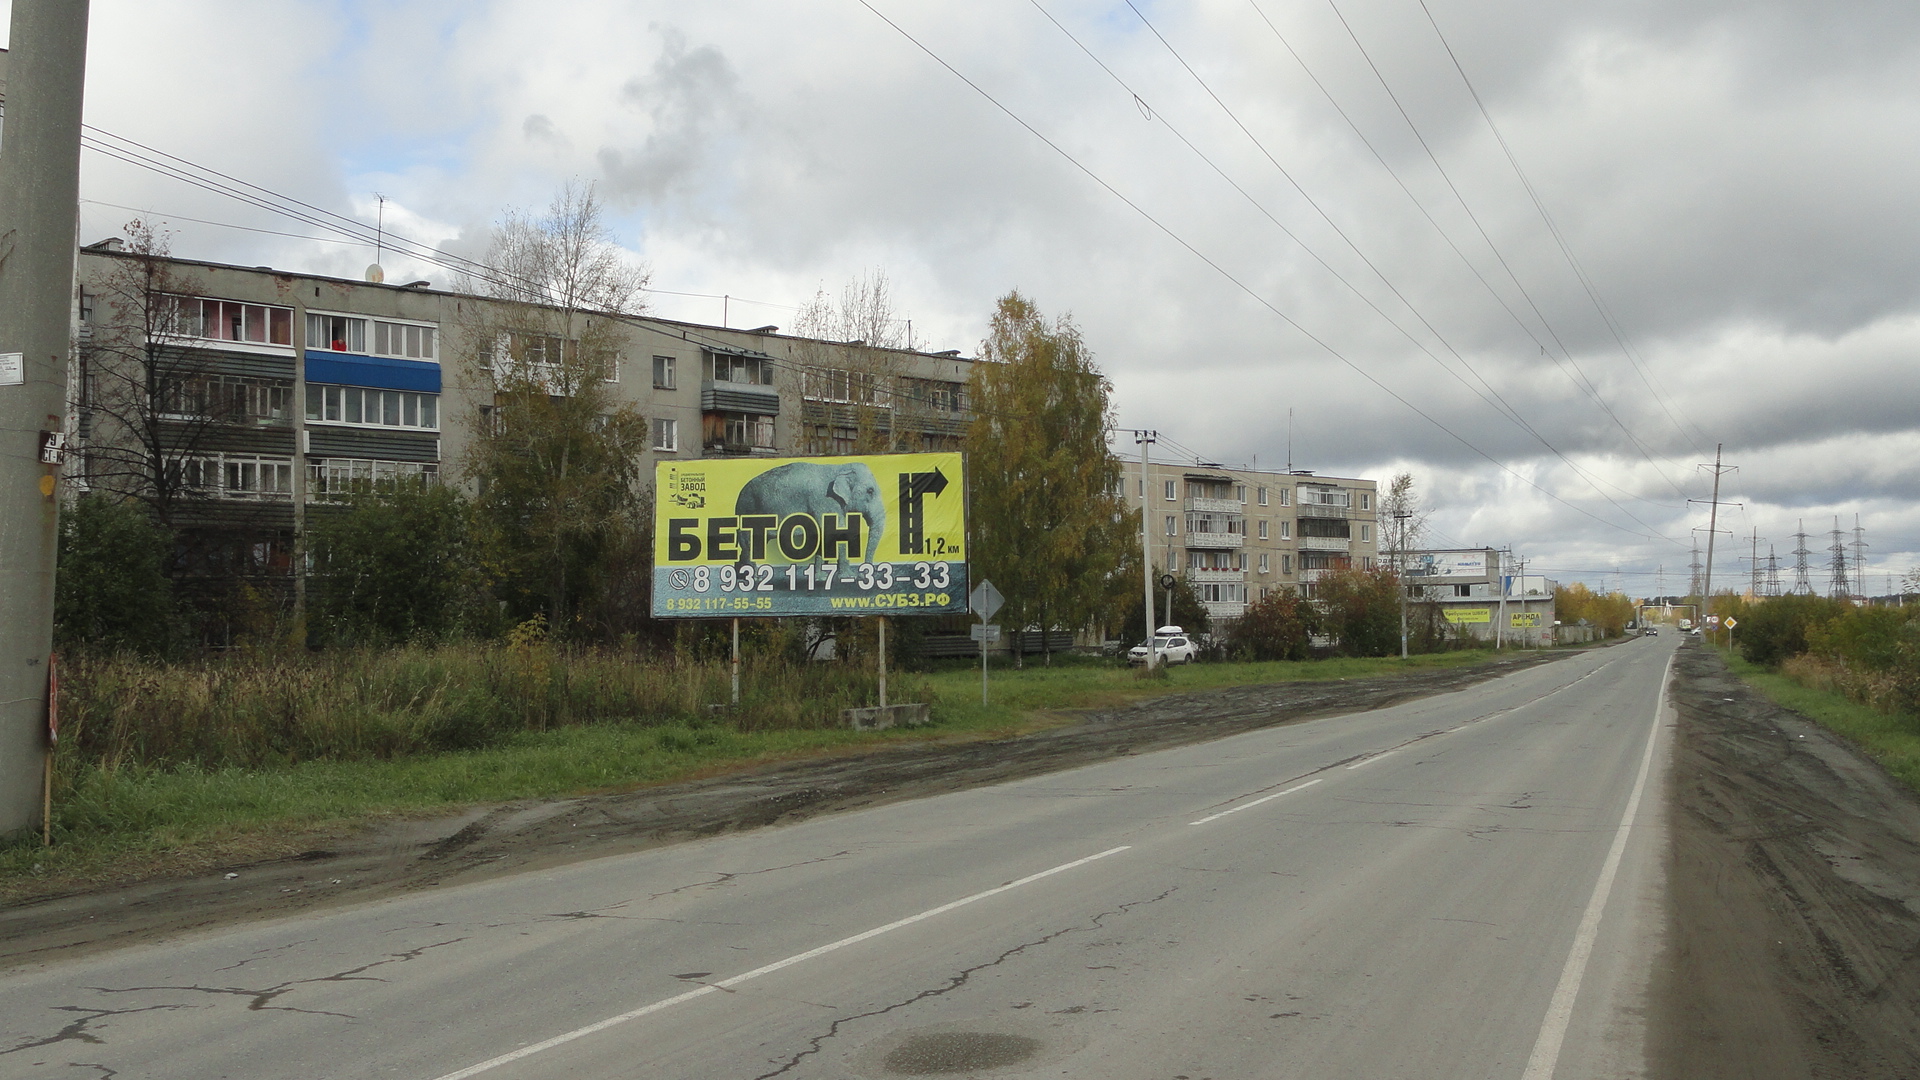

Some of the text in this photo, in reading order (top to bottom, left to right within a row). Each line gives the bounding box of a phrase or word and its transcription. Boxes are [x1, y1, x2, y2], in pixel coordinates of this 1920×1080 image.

[681, 483, 706, 492] ЗАВОД
[668, 514, 862, 561] БЕТОН
[925, 537, 945, 557] 1,2
[693, 561, 950, 593] 8 932 117-33-33
[667, 597, 772, 610] 8 932 117-55-55
[831, 593, 951, 609] www.СУБЗ.РФ
